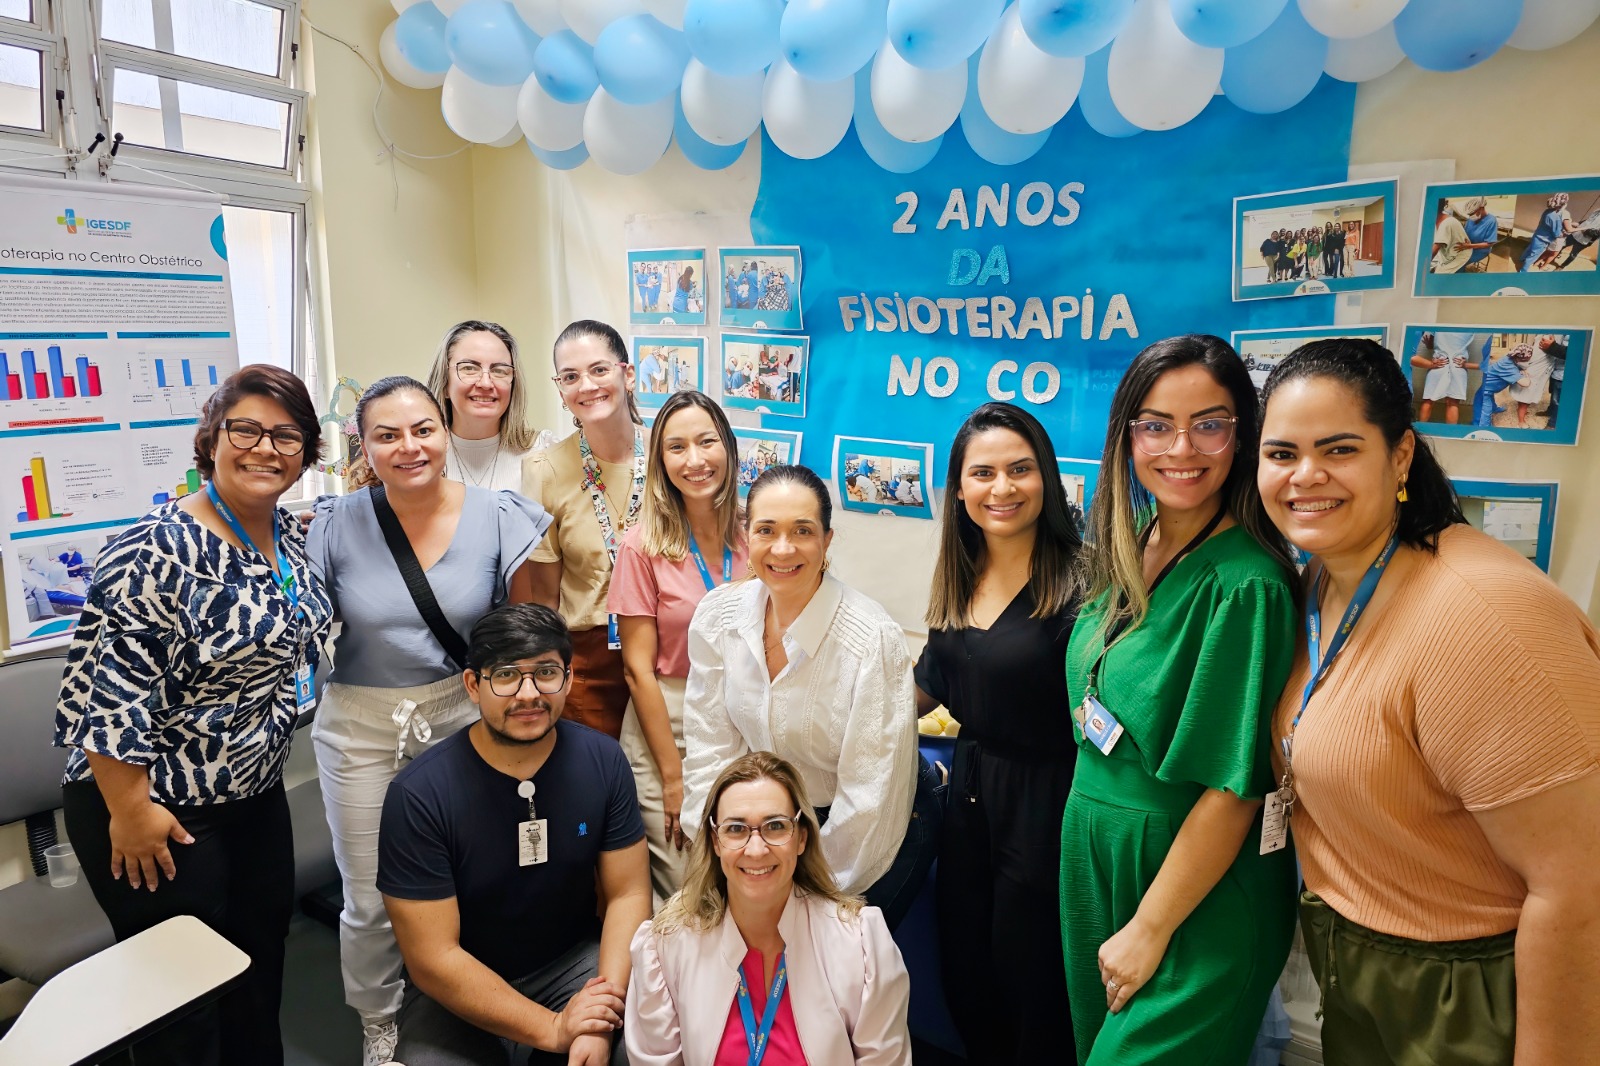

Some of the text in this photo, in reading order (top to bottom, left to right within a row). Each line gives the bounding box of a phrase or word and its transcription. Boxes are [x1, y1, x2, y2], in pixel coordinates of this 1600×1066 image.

[86, 218, 131, 230] IGESDF
[892, 182, 1085, 234] 2 ANOS
[69, 252, 87, 262] no
[90, 251, 136, 264] Centro
[139, 253, 203, 267] Obstétrico
[948, 245, 1010, 286] DA
[887, 355, 1061, 404] NO CO
